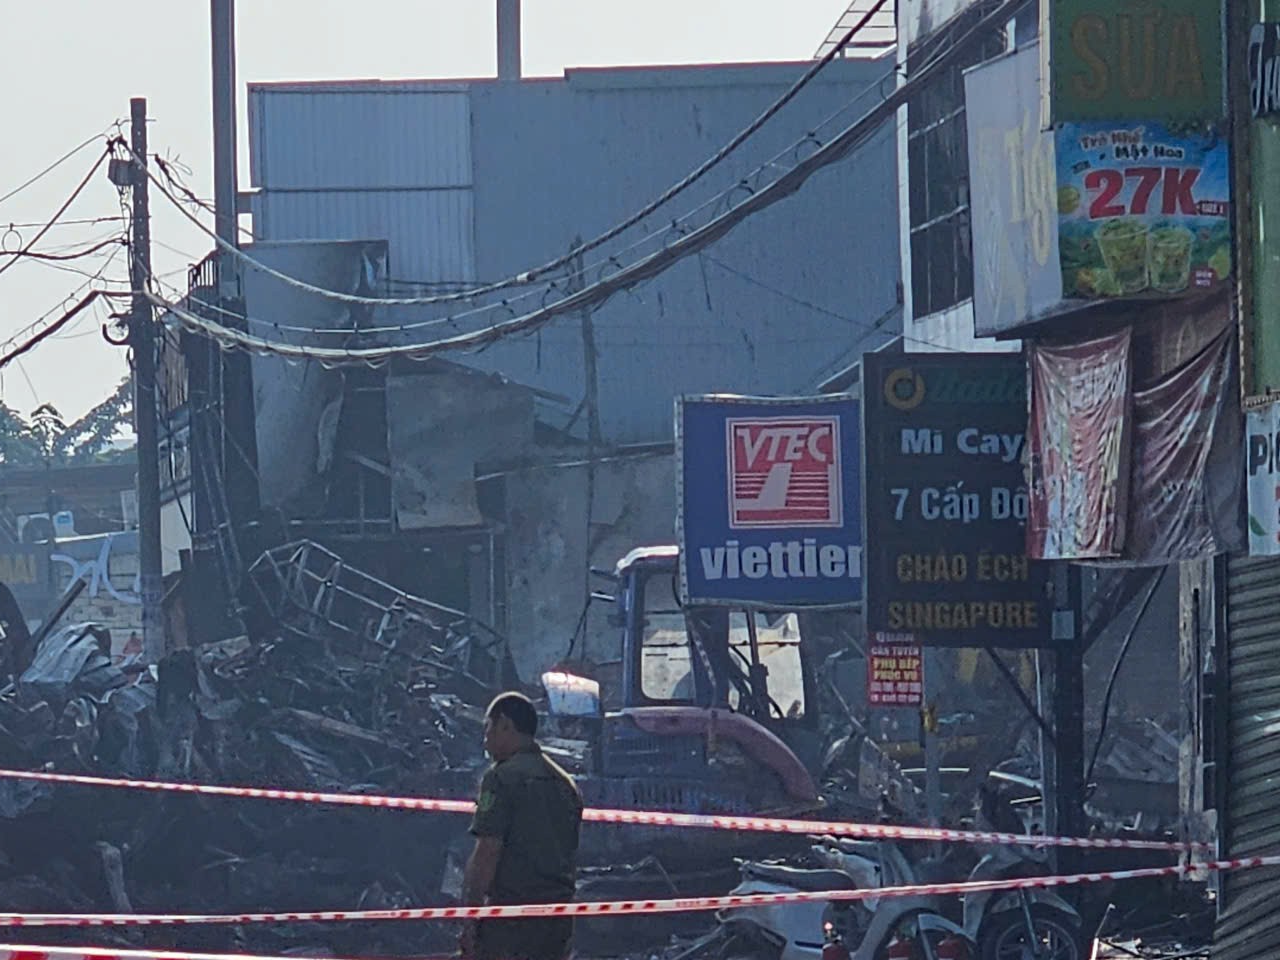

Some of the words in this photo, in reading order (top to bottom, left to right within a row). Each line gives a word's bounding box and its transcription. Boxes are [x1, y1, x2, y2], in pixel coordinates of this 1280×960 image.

[1084, 167, 1201, 218] 27K
[736, 427, 830, 467] VTEC
[958, 427, 1023, 462] Cay
[890, 486, 909, 519] 7
[921, 480, 980, 523] Cấp
[888, 600, 1038, 629] SINGAPORE
